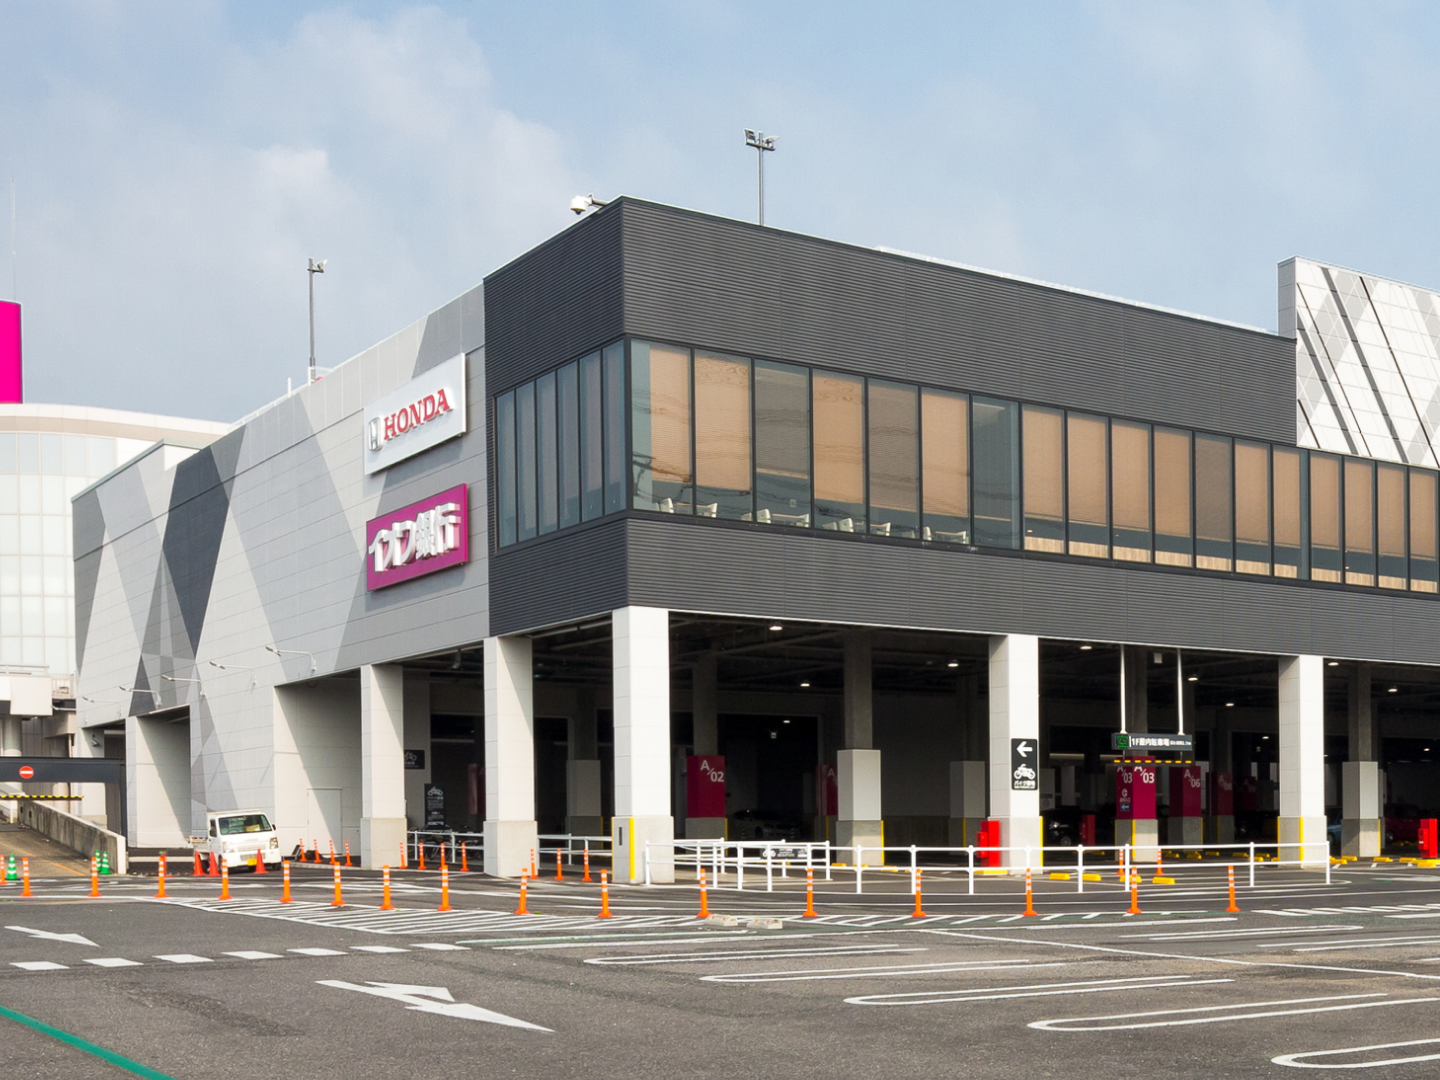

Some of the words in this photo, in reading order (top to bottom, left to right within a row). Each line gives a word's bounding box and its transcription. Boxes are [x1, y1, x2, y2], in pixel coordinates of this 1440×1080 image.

[384, 388, 450, 440] HONDA
[369, 502, 461, 572] イオン銀行
